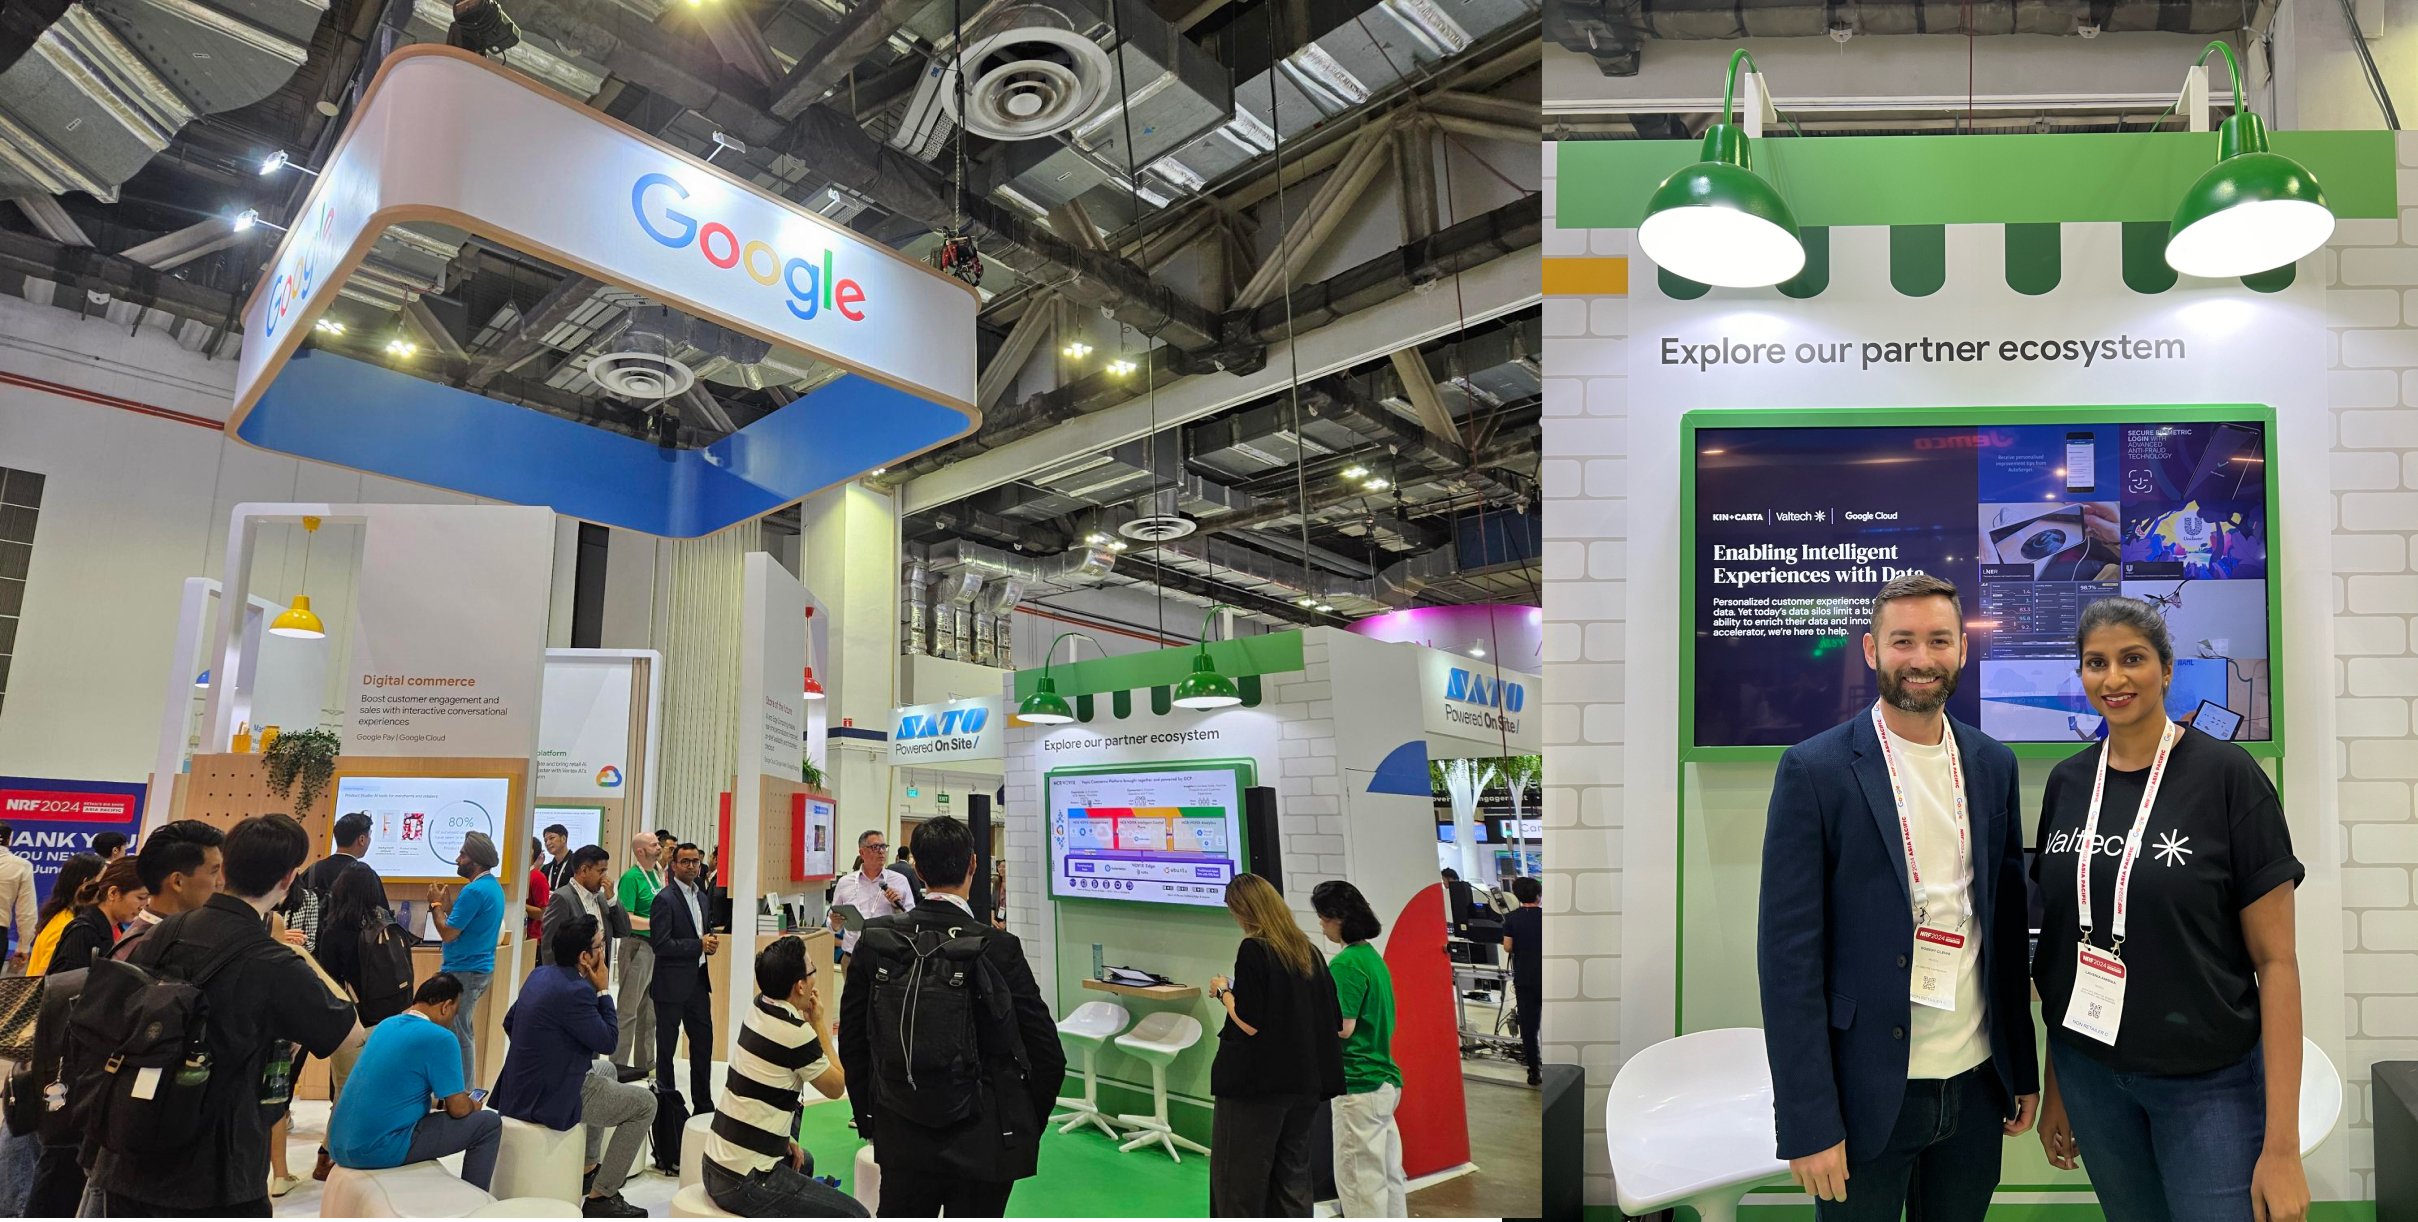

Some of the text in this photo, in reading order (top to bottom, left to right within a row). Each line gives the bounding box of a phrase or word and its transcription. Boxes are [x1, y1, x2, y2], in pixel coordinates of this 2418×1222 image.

[632, 172, 866, 321] Google
[266, 201, 335, 337] Google
[1660, 335, 2186, 372] Explore our partner ecosystem
[1776, 512, 1812, 522] Valtech
[1845, 512, 1898, 522] Google Cloud
[1713, 543, 1898, 564] Enabling Intelligent
[1713, 568, 1830, 588] Experiences
[1835, 566, 1877, 583] with
[1713, 598, 1870, 607] Personalized customer experiences
[1713, 608, 1736, 616] data.
[1738, 608, 1752, 616] Yet
[1754, 608, 1787, 618] today's
[1789, 608, 1810, 616] data
[1812, 608, 1831, 616] silos
[1833, 607, 1853, 615] limit
[1713, 618, 1740, 628] ability
[1755, 618, 1783, 626] enrich
[1830, 617, 1847, 625] and
[1713, 628, 1767, 637] accelerator,
[1768, 628, 1792, 636] we're
[1794, 627, 1814, 636] here
[1829, 627, 1849, 637] help.
[363, 675, 476, 688] Digital commerce
[1446, 667, 1525, 713] SATO
[361, 695, 386, 703] Boost
[387, 696, 428, 704] customer
[429, 697, 482, 705] engagement
[383, 706, 401, 714] with
[403, 707, 446, 715] interactive
[448, 708, 508, 716] conversational
[1446, 704, 1515, 734] Powered On Site
[358, 719, 410, 727] experiences
[896, 707, 989, 740] SATO
[1877, 719, 1887, 740] PACIFIC
[357, 734, 382, 742] Google
[399, 734, 425, 742] Google
[896, 738, 972, 755] Powered On Site
[1045, 729, 1220, 753] Explore our partner ecosystem
[2156, 749, 2166, 771] PACIFIC
[449, 817, 475, 828] 80%
[1902, 816, 1911, 840] PACIFIC
[2124, 847, 2135, 870] PACIFIC
[2084, 1023, 2105, 1035] RETAILER
